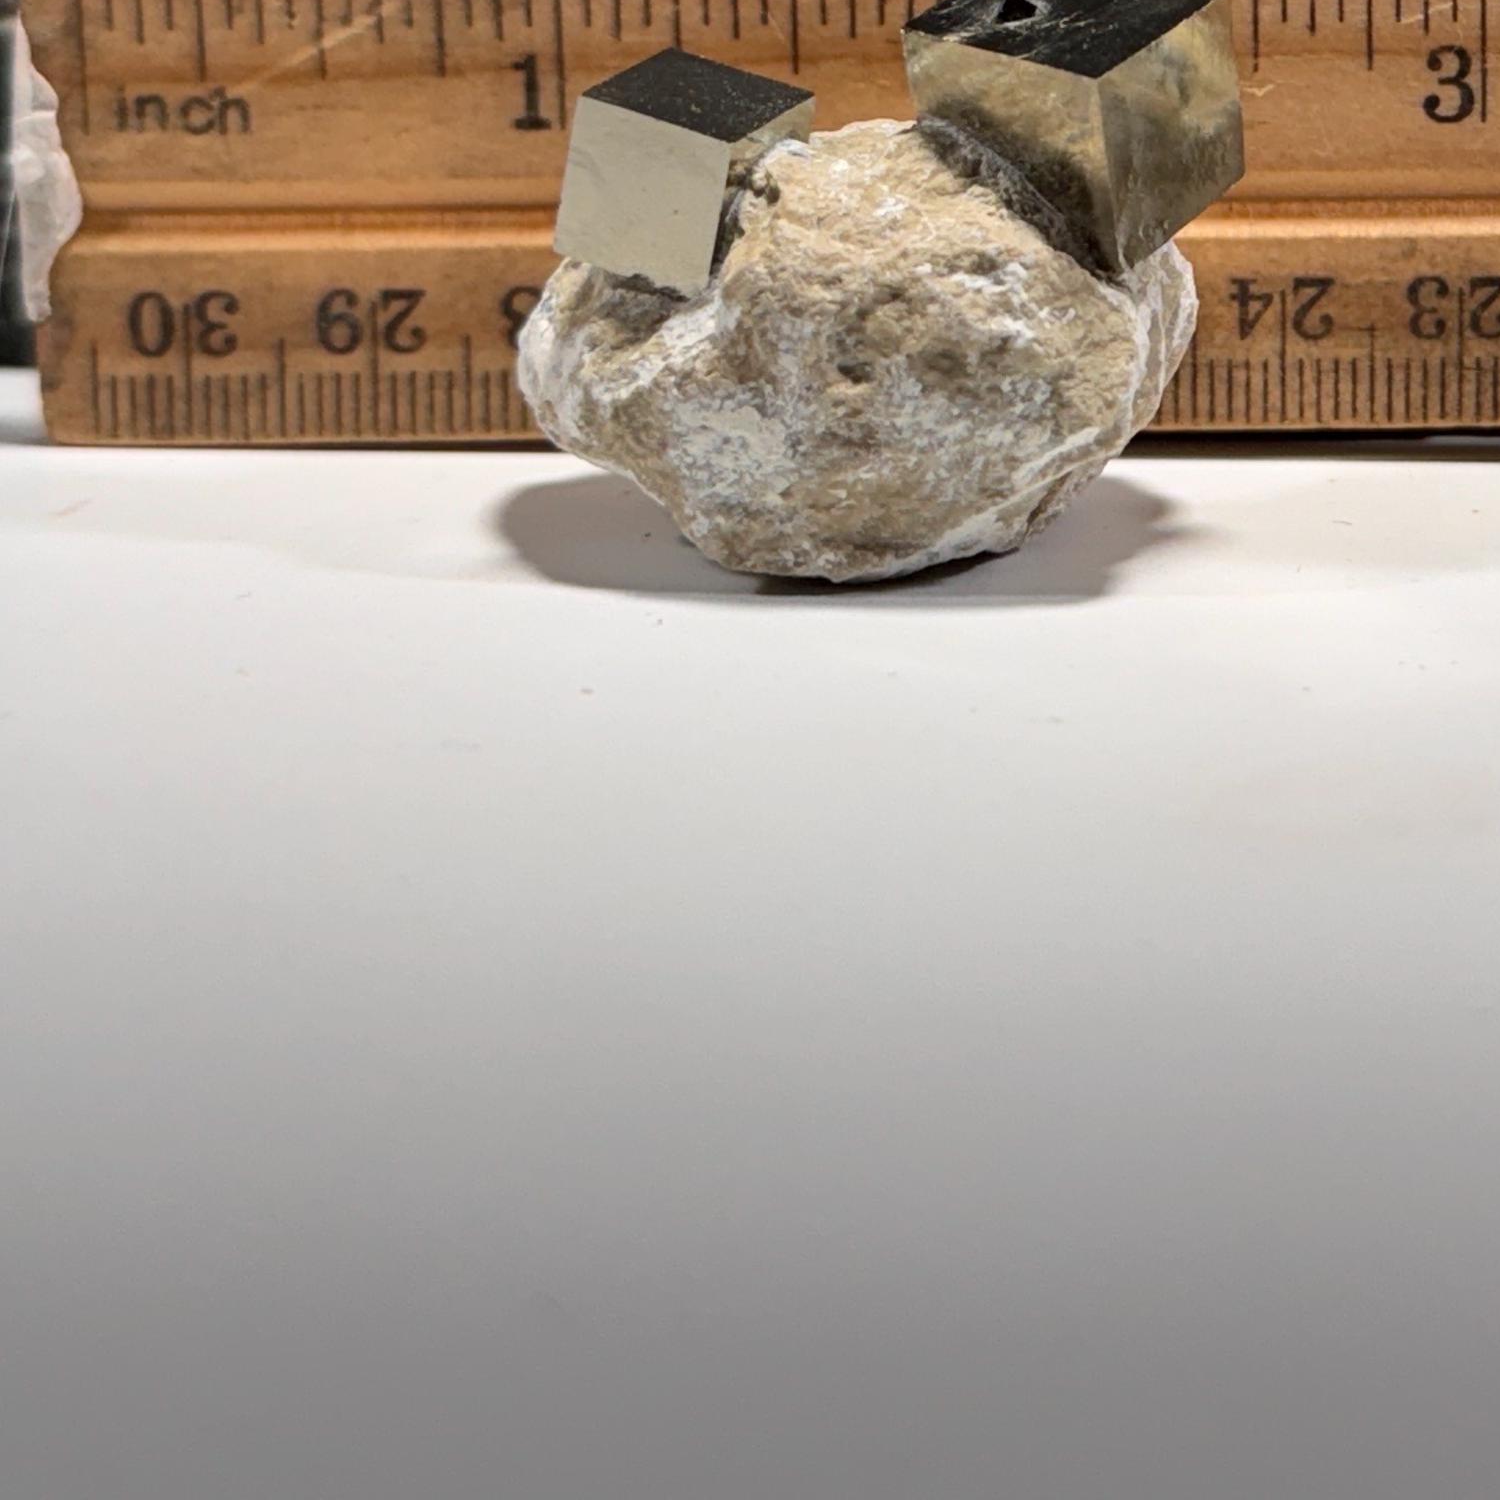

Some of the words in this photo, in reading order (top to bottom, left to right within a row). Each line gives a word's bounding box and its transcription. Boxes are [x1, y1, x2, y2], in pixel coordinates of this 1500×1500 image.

[110, 86, 252, 134] inch
[511, 54, 552, 131] 1
[1422, 44, 1476, 124] 3
[128, 289, 241, 358] 30
[315, 288, 428, 355] 29
[1230, 276, 1336, 340] 24
